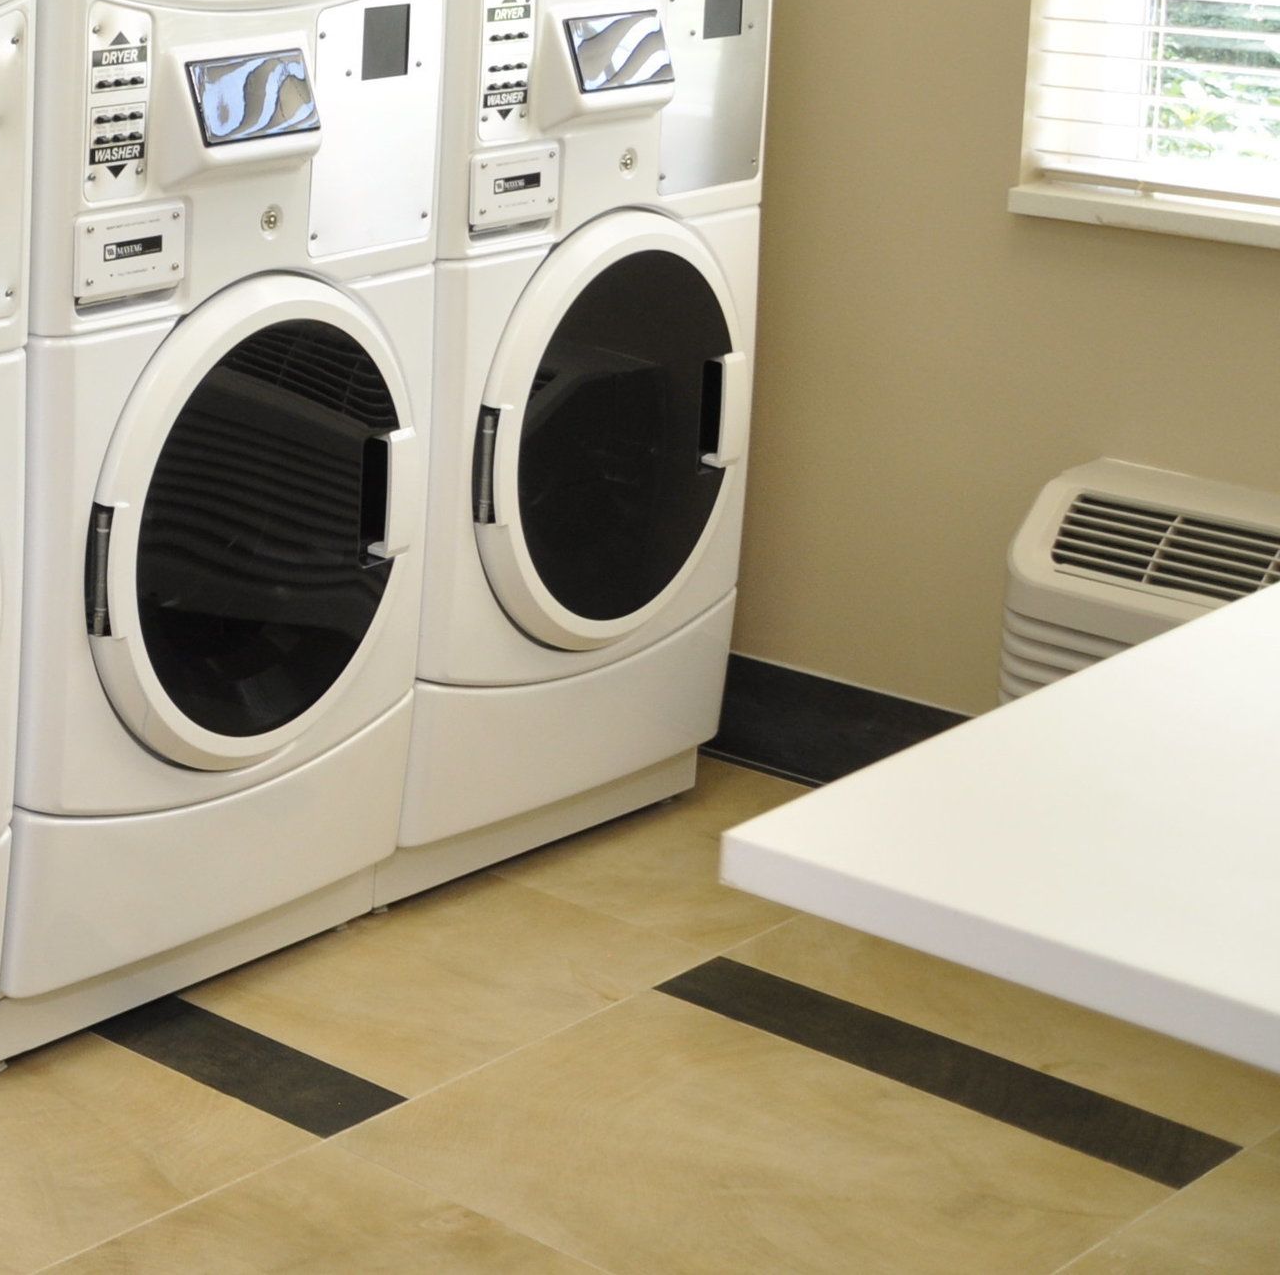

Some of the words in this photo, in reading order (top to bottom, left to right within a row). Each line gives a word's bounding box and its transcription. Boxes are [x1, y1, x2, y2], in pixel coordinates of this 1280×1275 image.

[494, 7, 525, 20] DRYER
[102, 49, 138, 65] DRYER
[487, 91, 524, 106] WASHER
[95, 145, 141, 162] WASHER
